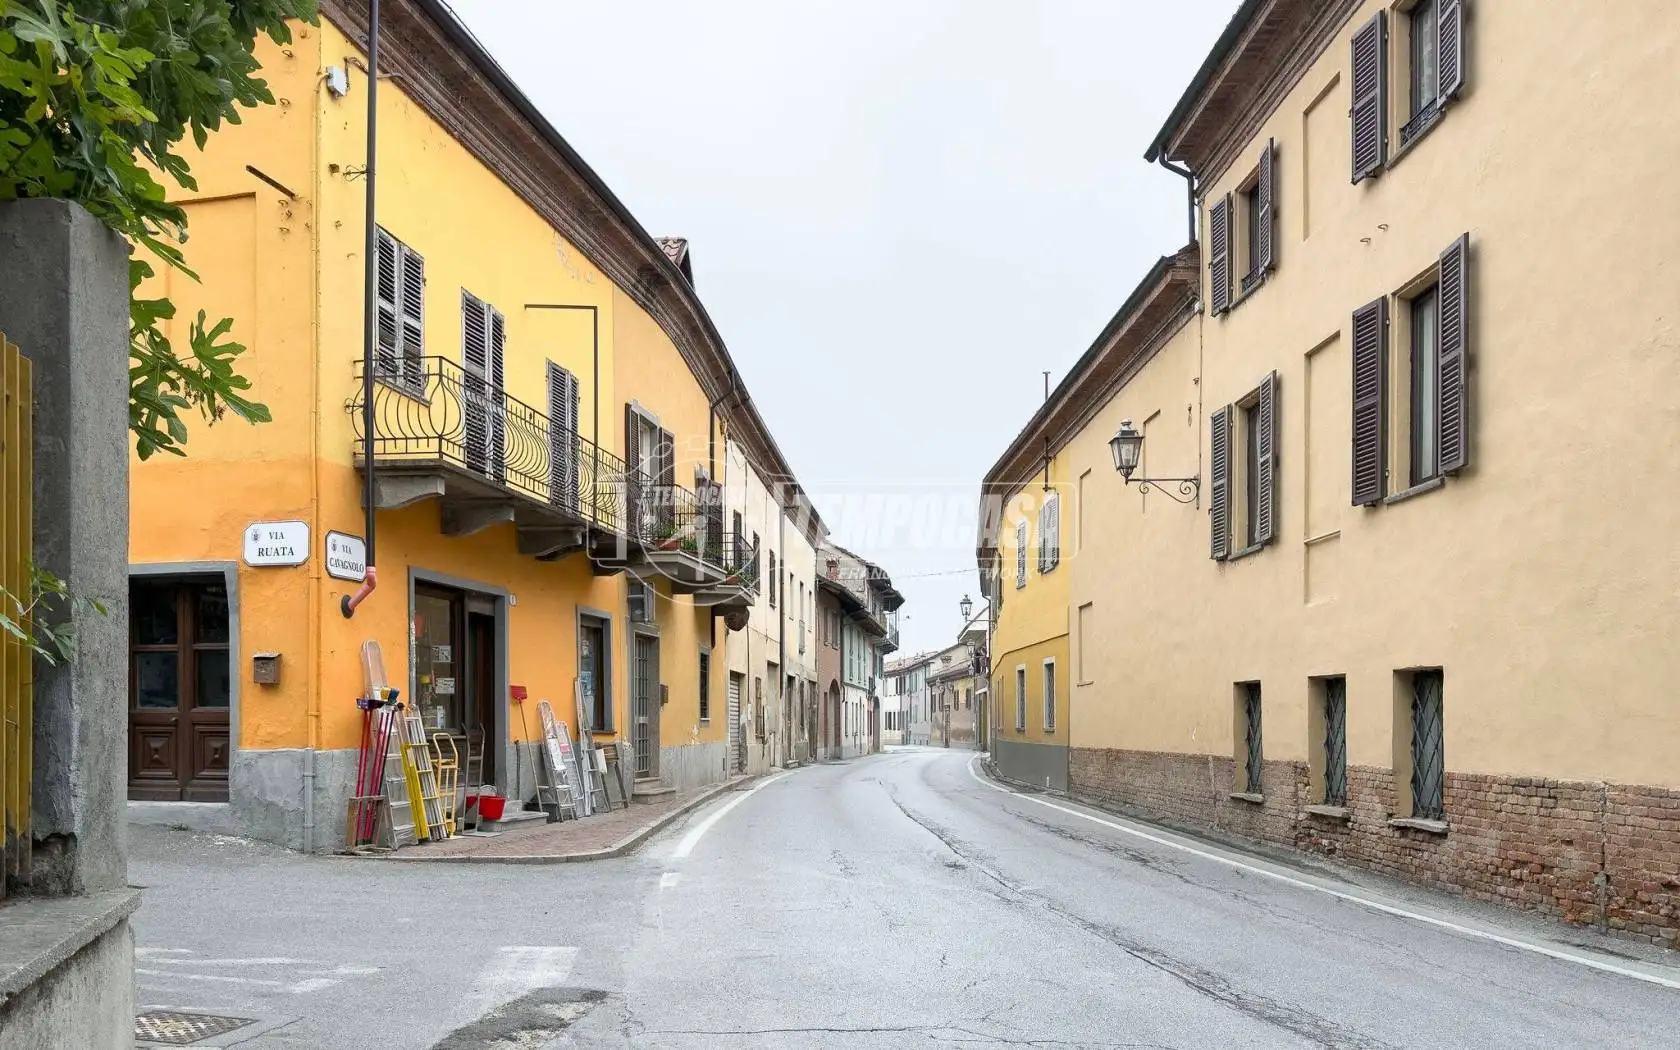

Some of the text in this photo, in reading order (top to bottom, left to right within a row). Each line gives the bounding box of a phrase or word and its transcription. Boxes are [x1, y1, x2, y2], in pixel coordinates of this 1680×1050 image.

[269, 531, 284, 540] VIA
[258, 546, 294, 557] RUATA
[342, 544, 352, 554] VIA
[330, 557, 364, 573] CAVAGNOLO
